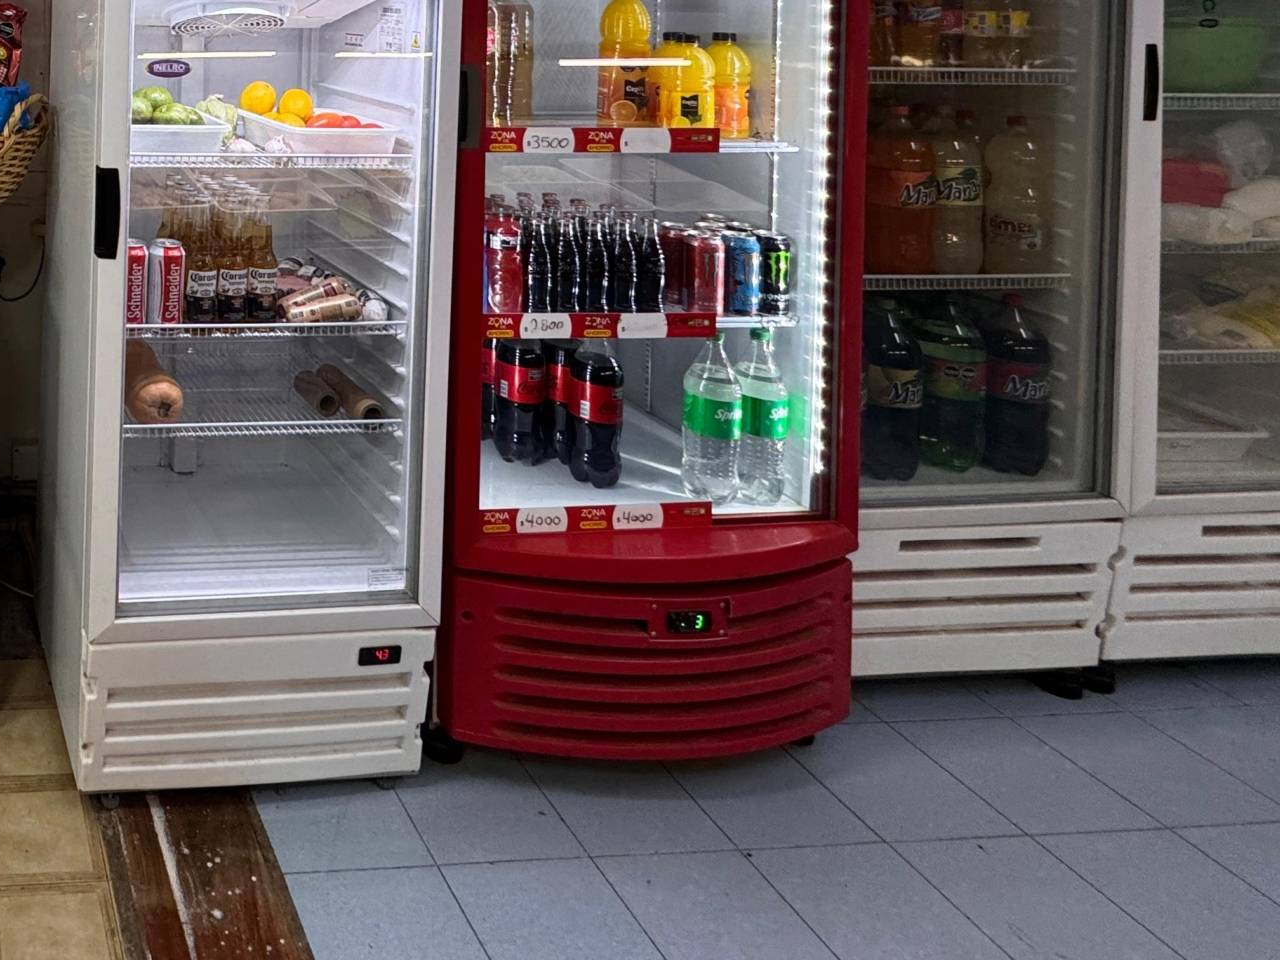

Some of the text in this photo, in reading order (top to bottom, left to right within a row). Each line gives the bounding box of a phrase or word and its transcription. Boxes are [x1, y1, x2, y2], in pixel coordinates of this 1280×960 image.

[153, 63, 185, 72] INELRO
[490, 131, 517, 141] ZONA
[588, 131, 614, 141] ZONA
[128, 263, 142, 319] Schneider
[165, 263, 180, 319] Schneider
[488, 317, 514, 327] ZONA
[484, 512, 510, 521] ZONA
[581, 509, 607, 518] ZONA
[695, 615, 704, 629] 3
